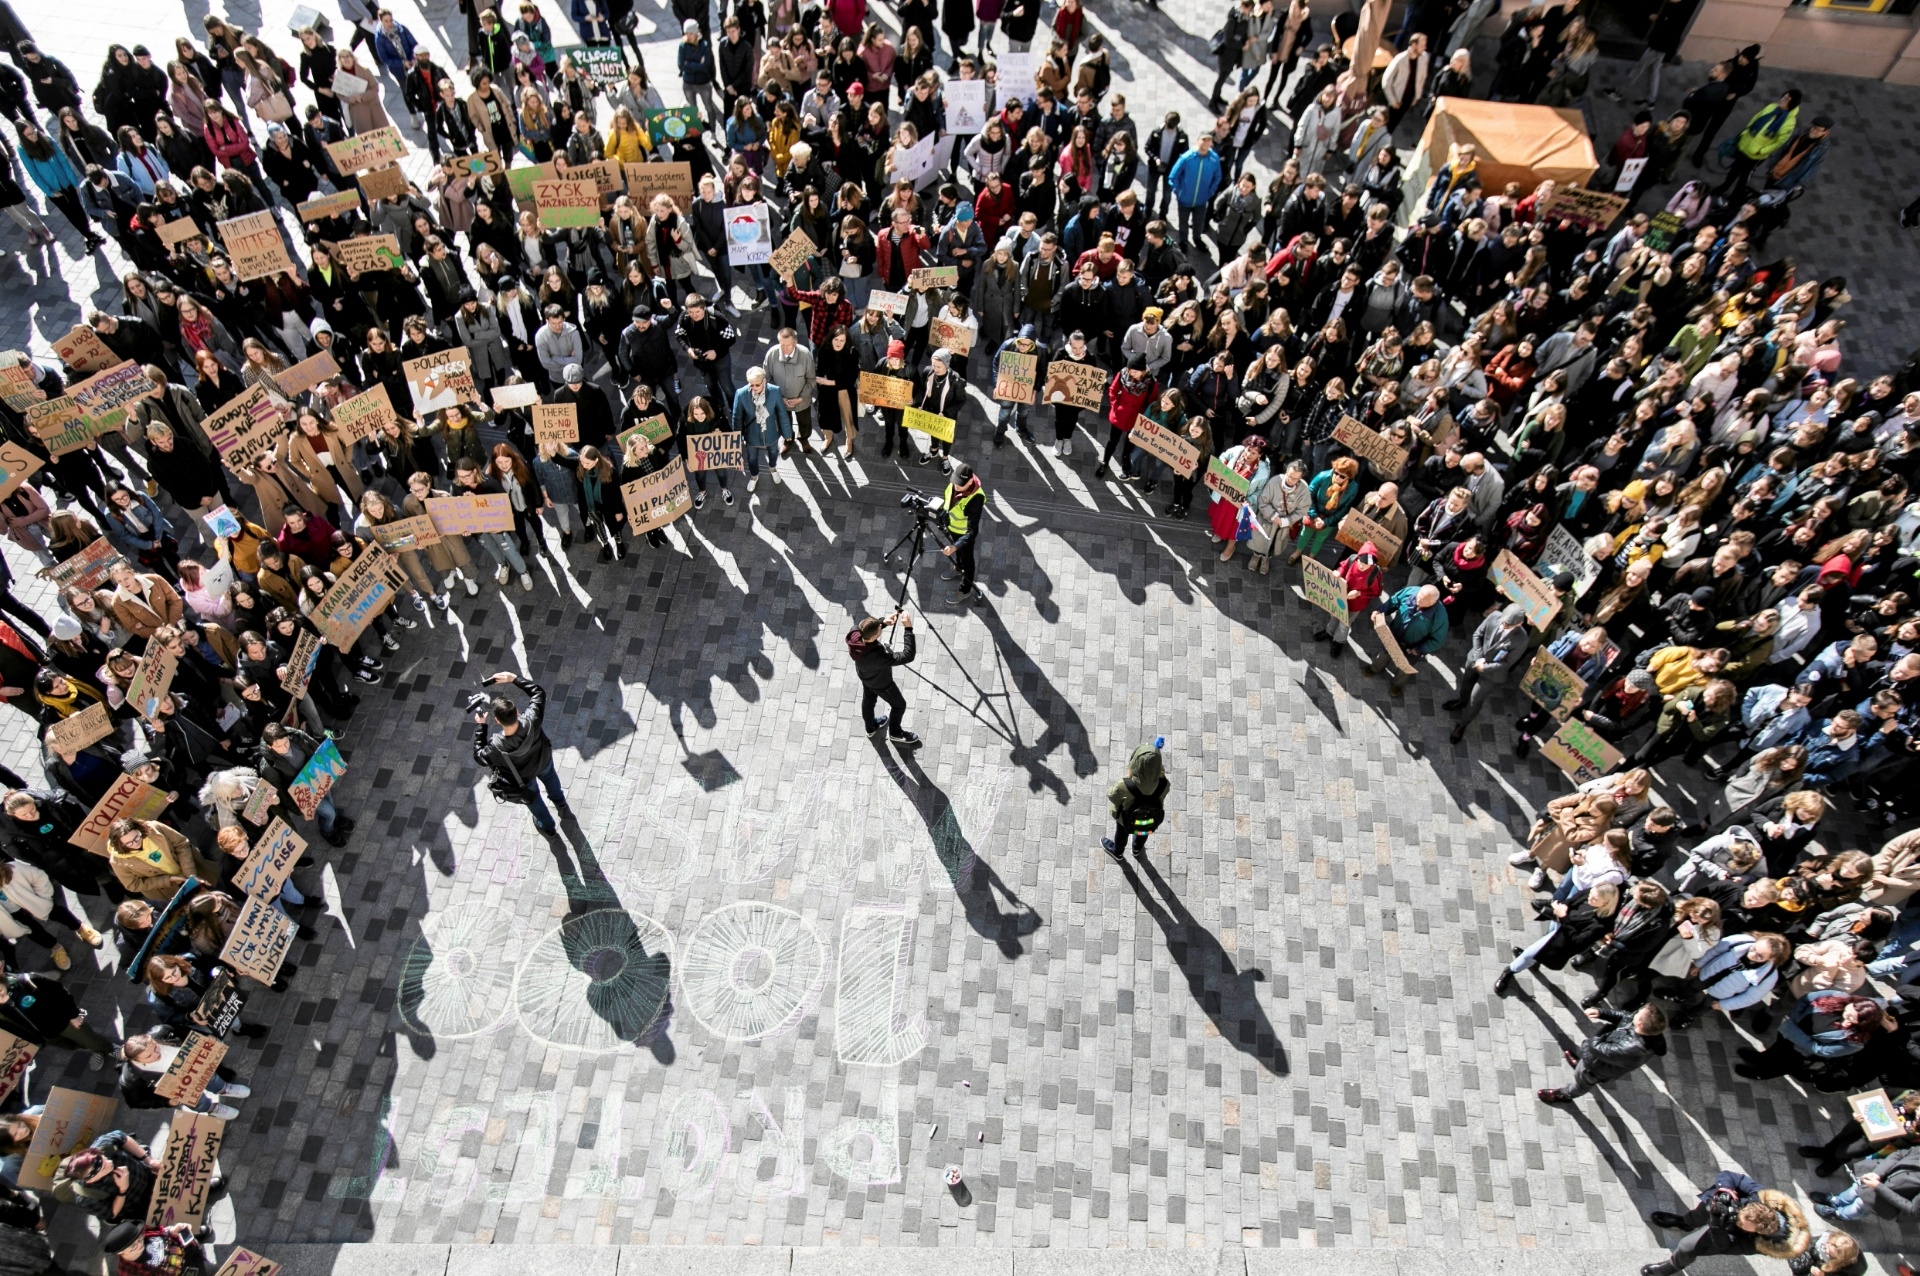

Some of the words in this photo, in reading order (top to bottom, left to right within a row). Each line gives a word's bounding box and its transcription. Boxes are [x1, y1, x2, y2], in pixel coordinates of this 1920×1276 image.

[572, 50, 618, 64] PLASTIC
[590, 63, 600, 74] IS
[600, 63, 620, 75] NOT
[627, 168, 653, 183] Homo
[655, 170, 686, 183] sapiens
[537, 182, 584, 198] ZYSK
[228, 227, 283, 253] HOTTEST
[783, 239, 797, 252] MA
[353, 257, 387, 272] CZAS
[922, 276, 947, 287] POJĘCIE
[412, 351, 452, 373] POLACY
[1000, 363, 1029, 377] RYBY
[1001, 351, 1026, 365] DZIECI
[1049, 363, 1087, 376] SZKOŁA
[1090, 369, 1105, 383] NIE
[997, 380, 1028, 401] GŁOS
[1076, 388, 1089, 397] NIE
[29, 395, 76, 420] OSTATNI
[335, 394, 370, 419] KLIMAT
[539, 407, 570, 417] THERE
[907, 409, 928, 421] MAKE
[35, 411, 73, 430] CZAS
[63, 417, 86, 432] NA
[235, 414, 257, 437] NIE
[346, 409, 383, 434] DLACZEGO
[44, 424, 89, 452] ZMIANY
[352, 427, 367, 440] MY
[691, 434, 741, 452] YOUTH
[1138, 416, 1160, 435] YOU
[1158, 432, 1178, 446] won't
[1177, 441, 1188, 455] be
[1344, 419, 1400, 460] EDUKUJCIE
[707, 451, 742, 469] POWER
[1133, 429, 1150, 443] able
[1178, 456, 1193, 470] US
[1333, 427, 1353, 445] NIE
[1351, 437, 1401, 473] EMITUJCIE
[627, 484, 637, 495] Z
[641, 457, 682, 489] POPIOŁU
[454, 501, 471, 510] the
[651, 479, 688, 508] PLASTIK
[634, 514, 650, 527] SIĘ
[1546, 543, 1562, 558] OUR
[1551, 527, 1565, 546] WE
[1561, 539, 1578, 558] ARE
[1548, 554, 1559, 564] TO
[319, 582, 352, 620] KRAINA
[348, 545, 383, 583] WĘGLEM
[1303, 558, 1342, 594] ZMIANA
[341, 570, 377, 610] SMOGIEM
[1306, 579, 1334, 601] PONAD
[144, 640, 160, 660] TOPI
[136, 689, 147, 706] TY
[145, 646, 165, 684] RAZEM
[148, 687, 156, 698] Z
[153, 663, 166, 686] NIM
[79, 776, 140, 838] POLITYCY
[236, 866, 250, 885] LIKE
[250, 850, 261, 863] THE
[260, 836, 270, 849] SEA
[270, 820, 285, 839] LEVEL
[256, 874, 275, 899] WE
[273, 839, 296, 871] RISE
[228, 937, 249, 962] ALL
[243, 900, 263, 929] WANT
[258, 912, 284, 956] CLIMATE
[239, 942, 258, 967] FOR
[258, 928, 289, 981] JUSTICE
[213, 991, 240, 1030] PALENIE
[217, 998, 244, 1037] ZABIJA
[7, 1050, 32, 1081] YOU
[167, 1030, 202, 1076] PLANET
[174, 1040, 216, 1099] HOTTER
[187, 1062, 216, 1106] LEONARDO
[50, 1119, 69, 1148] ŻYĆ
[329, 1078, 901, 1207] PROTEST
